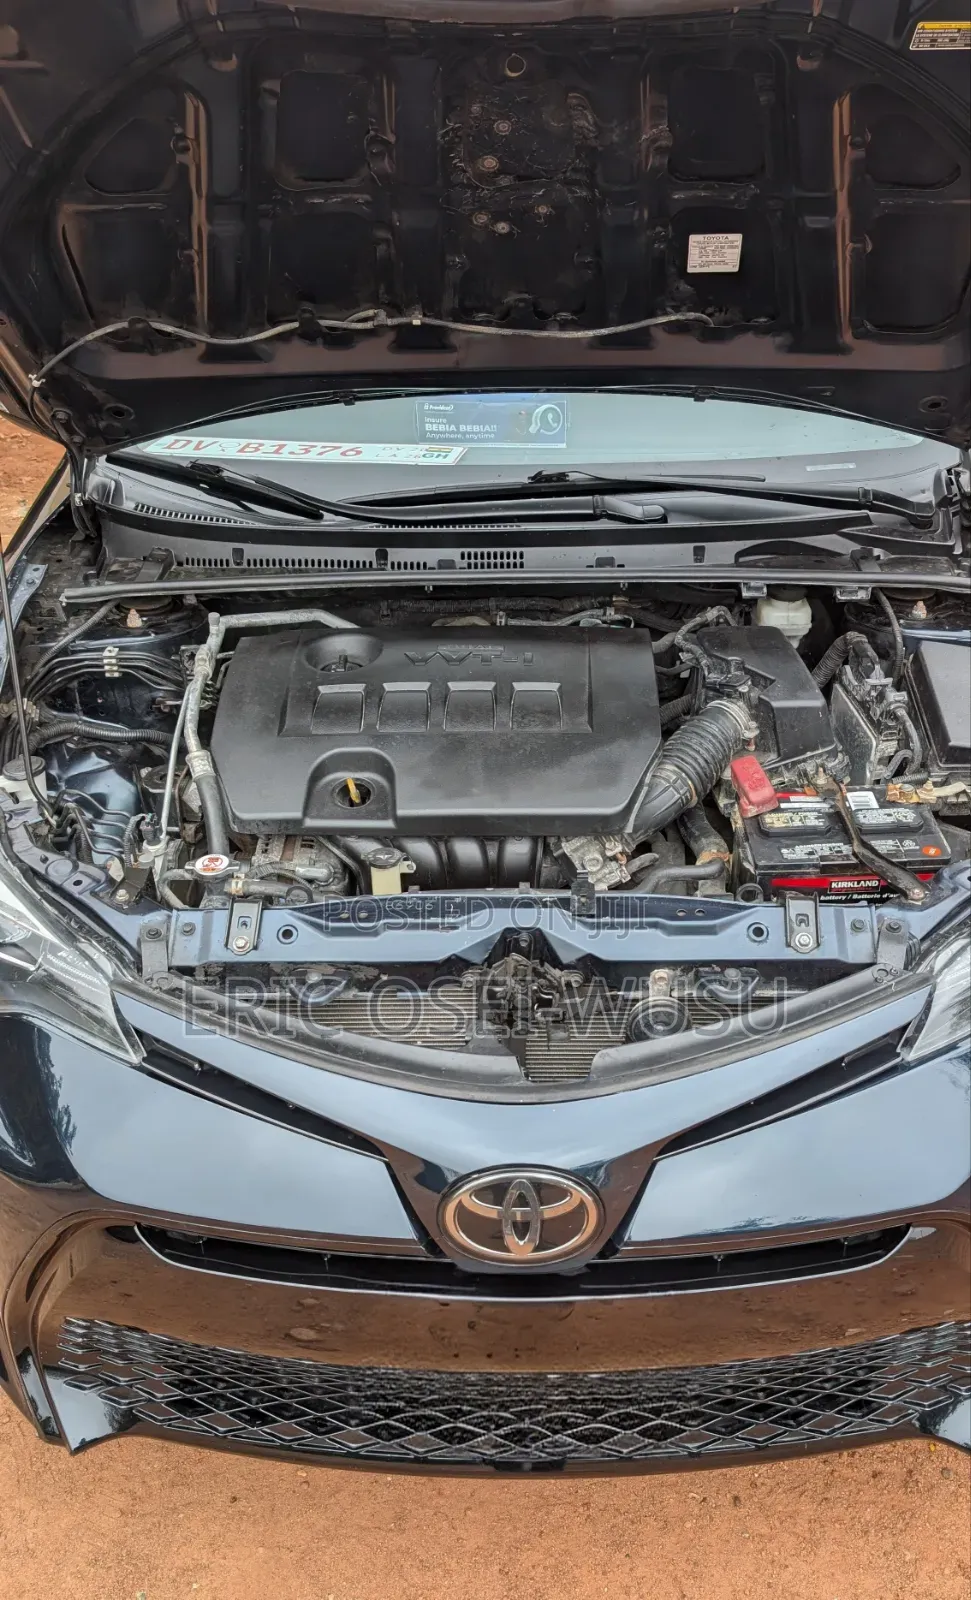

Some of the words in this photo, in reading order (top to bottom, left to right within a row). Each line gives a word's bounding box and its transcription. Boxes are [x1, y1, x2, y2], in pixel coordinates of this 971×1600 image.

[162, 439, 218, 451] DV
[236, 442, 363, 457] B1376
[831, 880, 879, 888] KIRKLAND
